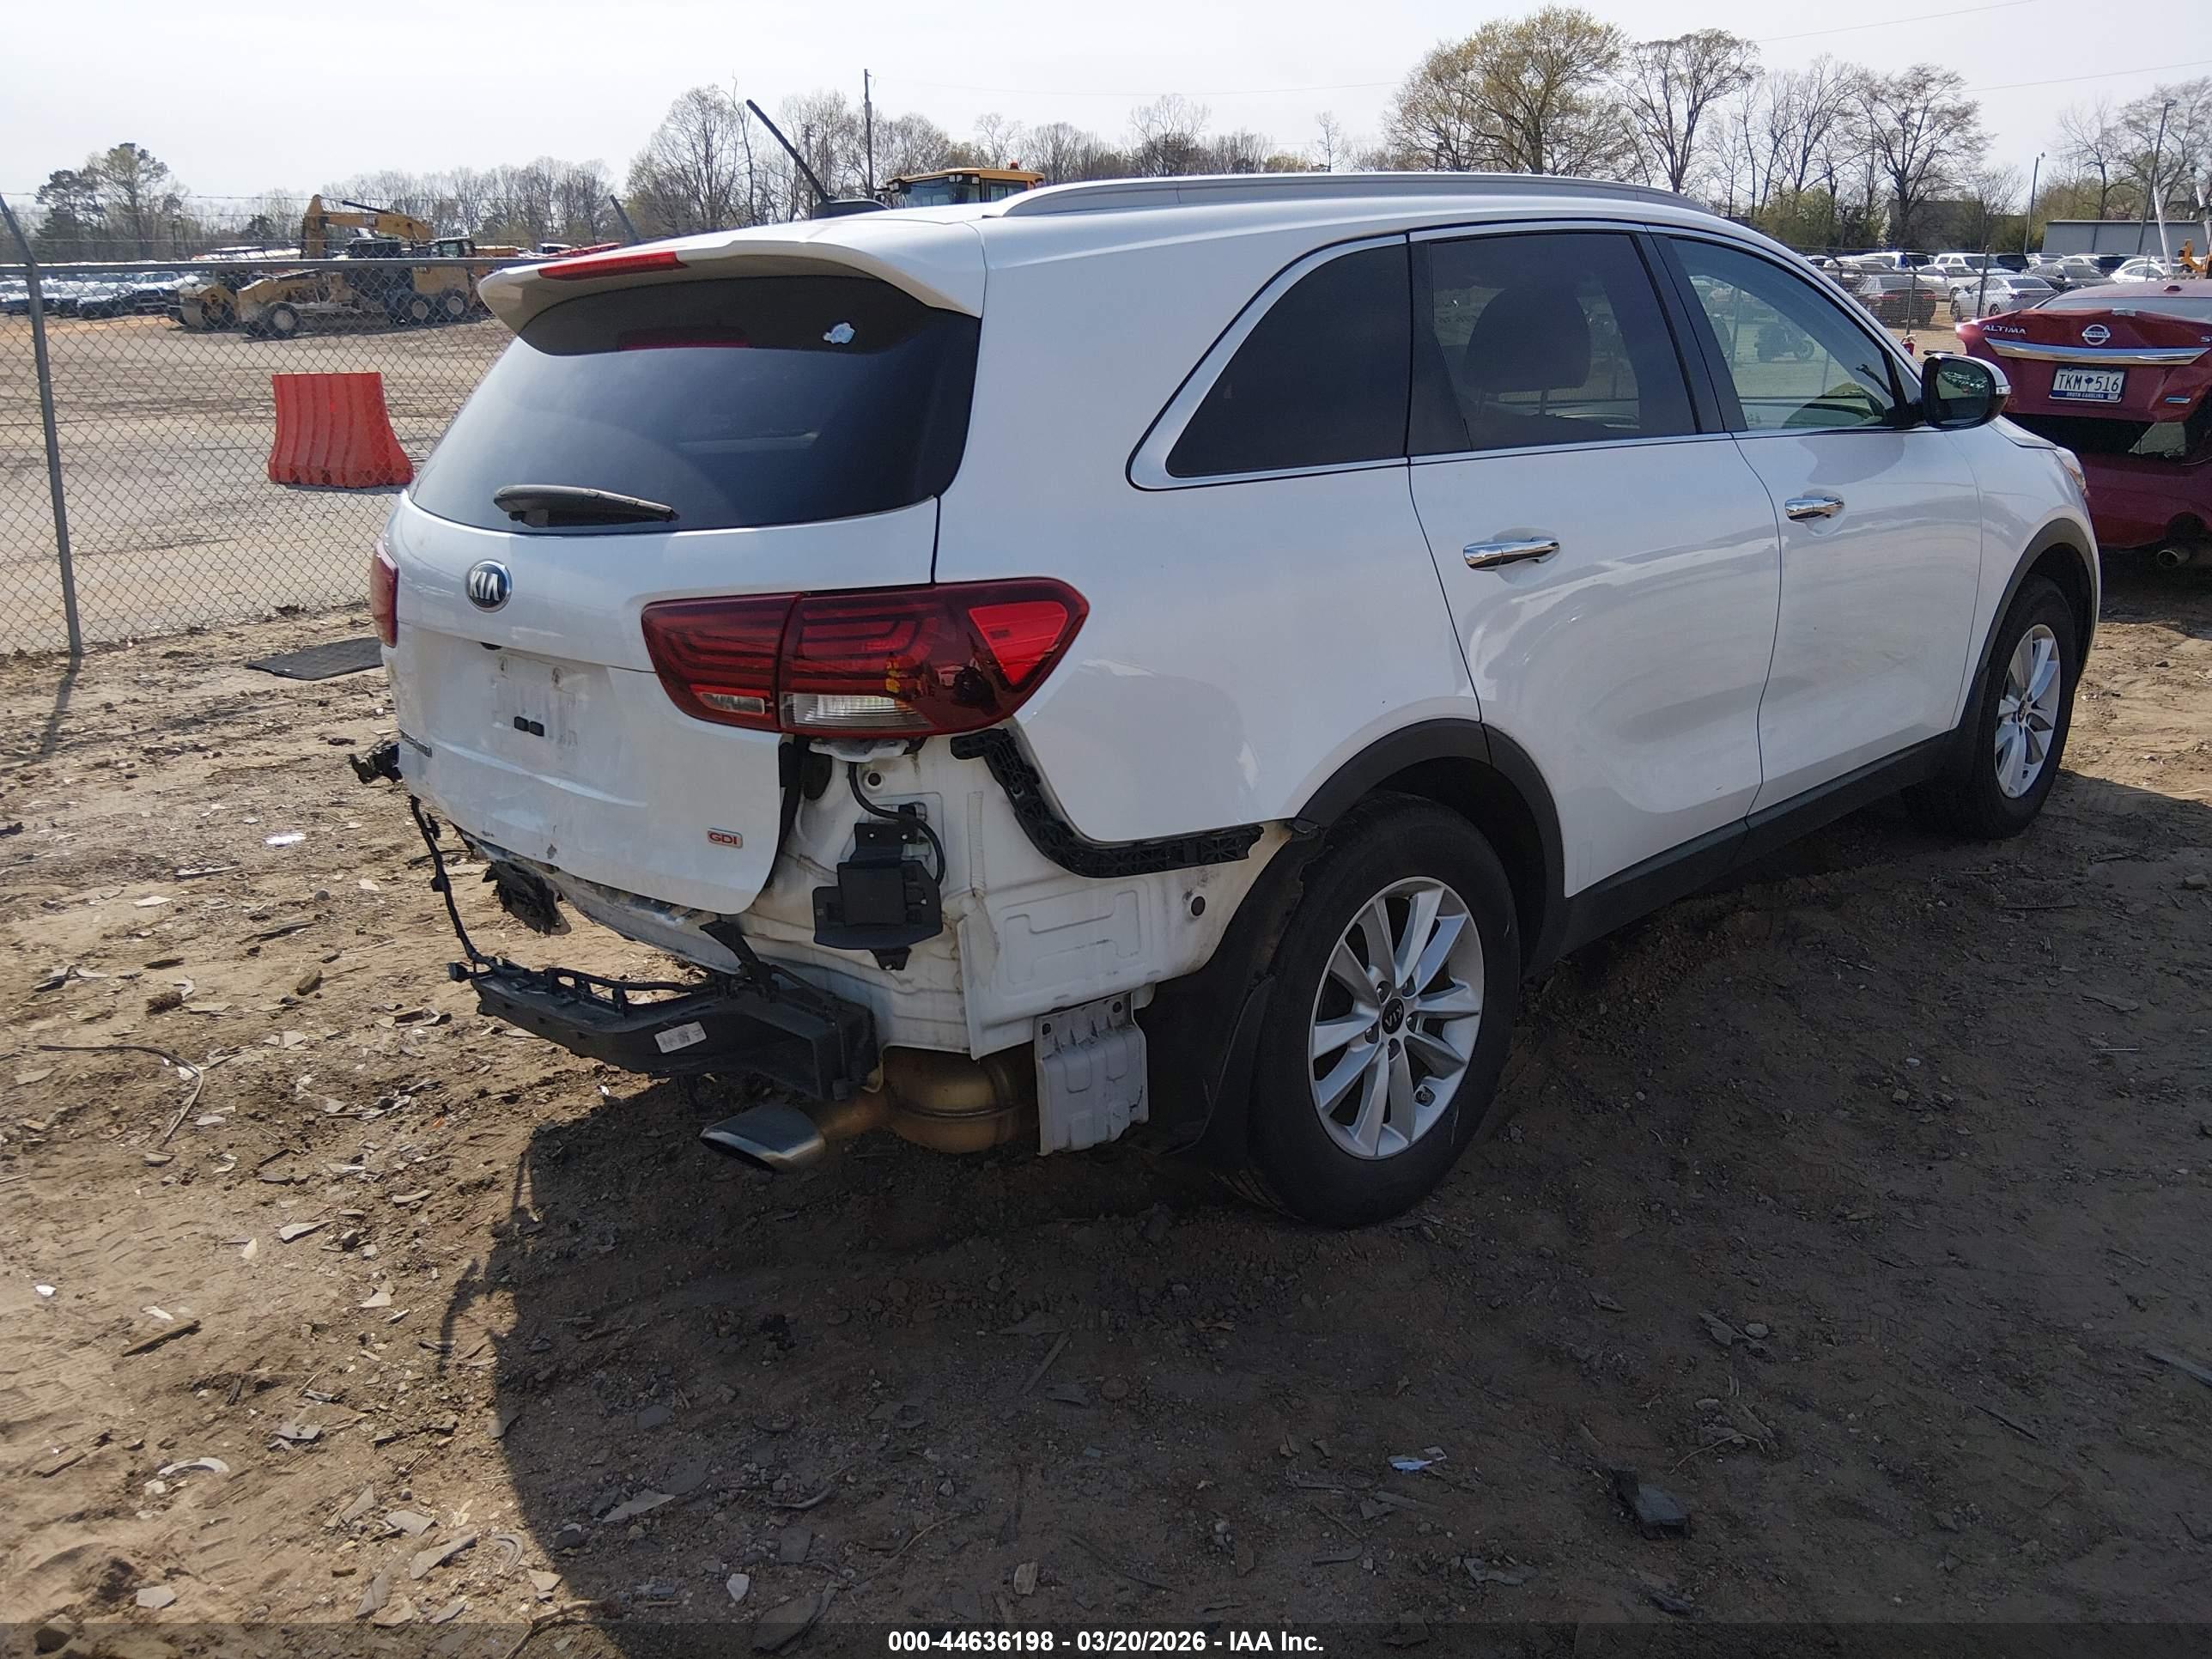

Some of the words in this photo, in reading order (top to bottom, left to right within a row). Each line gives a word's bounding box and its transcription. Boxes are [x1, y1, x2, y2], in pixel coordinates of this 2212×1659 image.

[1982, 325, 2027, 335] ALTIMA
[2058, 374, 2083, 391] TKM
[2094, 375, 2119, 392] 516
[470, 570, 501, 601] KIA
[709, 832, 738, 845] GDI
[1384, 1005, 1403, 1027] KIA
